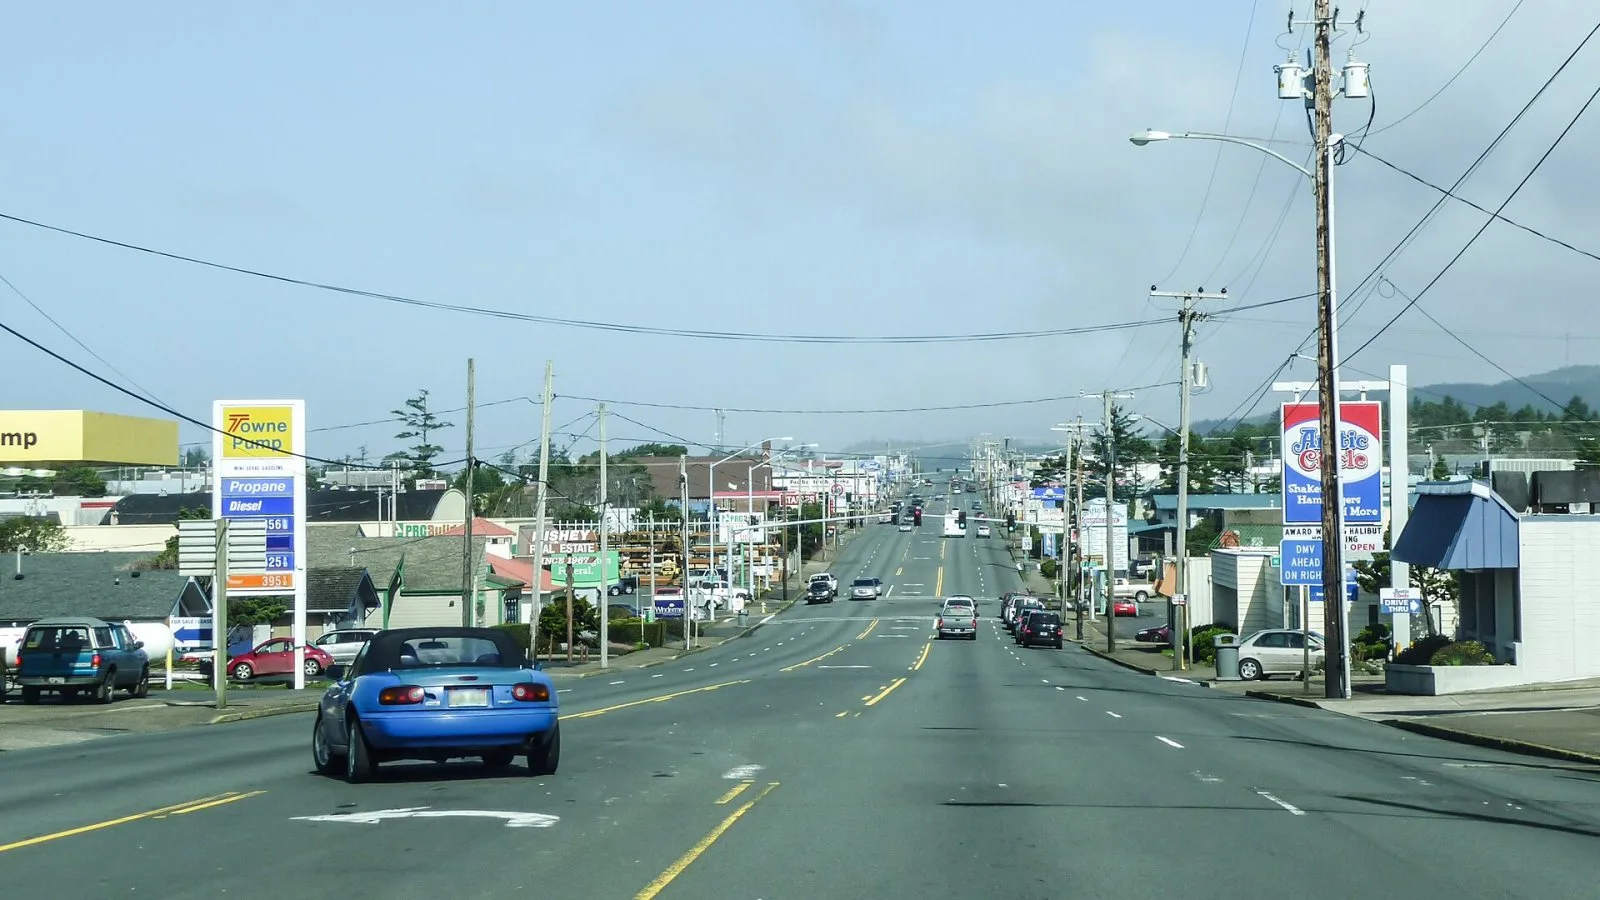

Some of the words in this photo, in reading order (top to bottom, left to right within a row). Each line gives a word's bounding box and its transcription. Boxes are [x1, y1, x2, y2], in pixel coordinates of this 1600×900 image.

[228, 414, 287, 432] Towne
[233, 437, 281, 452] Pump
[230, 481, 286, 494] Propane
[229, 501, 262, 511] Diesel
[1350, 507, 1378, 516] More
[532, 530, 591, 541] ISHEY
[529, 544, 555, 554] RAL
[560, 543, 594, 553] ESTATE
[1296, 545, 1315, 554] DMV
[541, 557, 565, 565] INCE
[567, 556, 589, 564] 1967
[1291, 558, 1320, 567] AHEAD
[1285, 571, 1297, 580] ON
[1301, 571, 1322, 580] RIGH
[262, 576, 282, 586] 395
